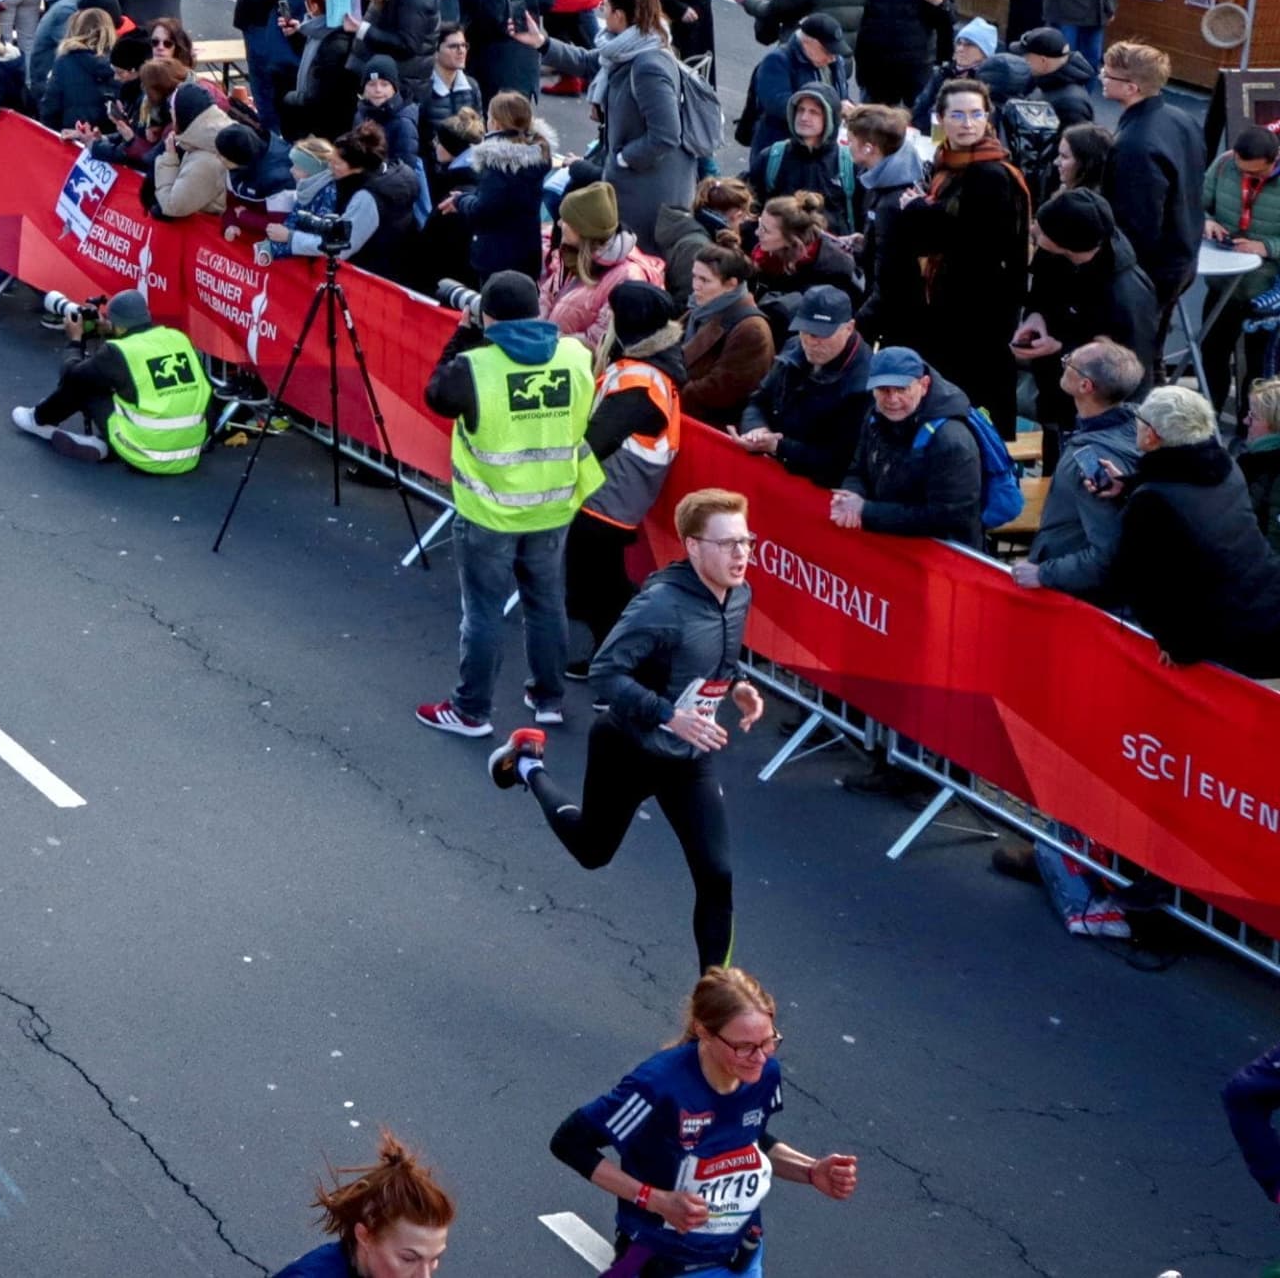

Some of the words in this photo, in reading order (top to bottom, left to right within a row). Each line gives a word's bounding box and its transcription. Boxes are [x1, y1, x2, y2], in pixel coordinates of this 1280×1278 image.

[90, 224, 131, 255] ERLINER
[103, 208, 145, 240] GENERALI
[195, 267, 242, 303] BERLINER
[208, 253, 262, 289] GENERALI
[758, 539, 889, 637] GENERALI
[1200, 773, 1279, 833] EVEN
[715, 1153, 757, 1169] GENERALI
